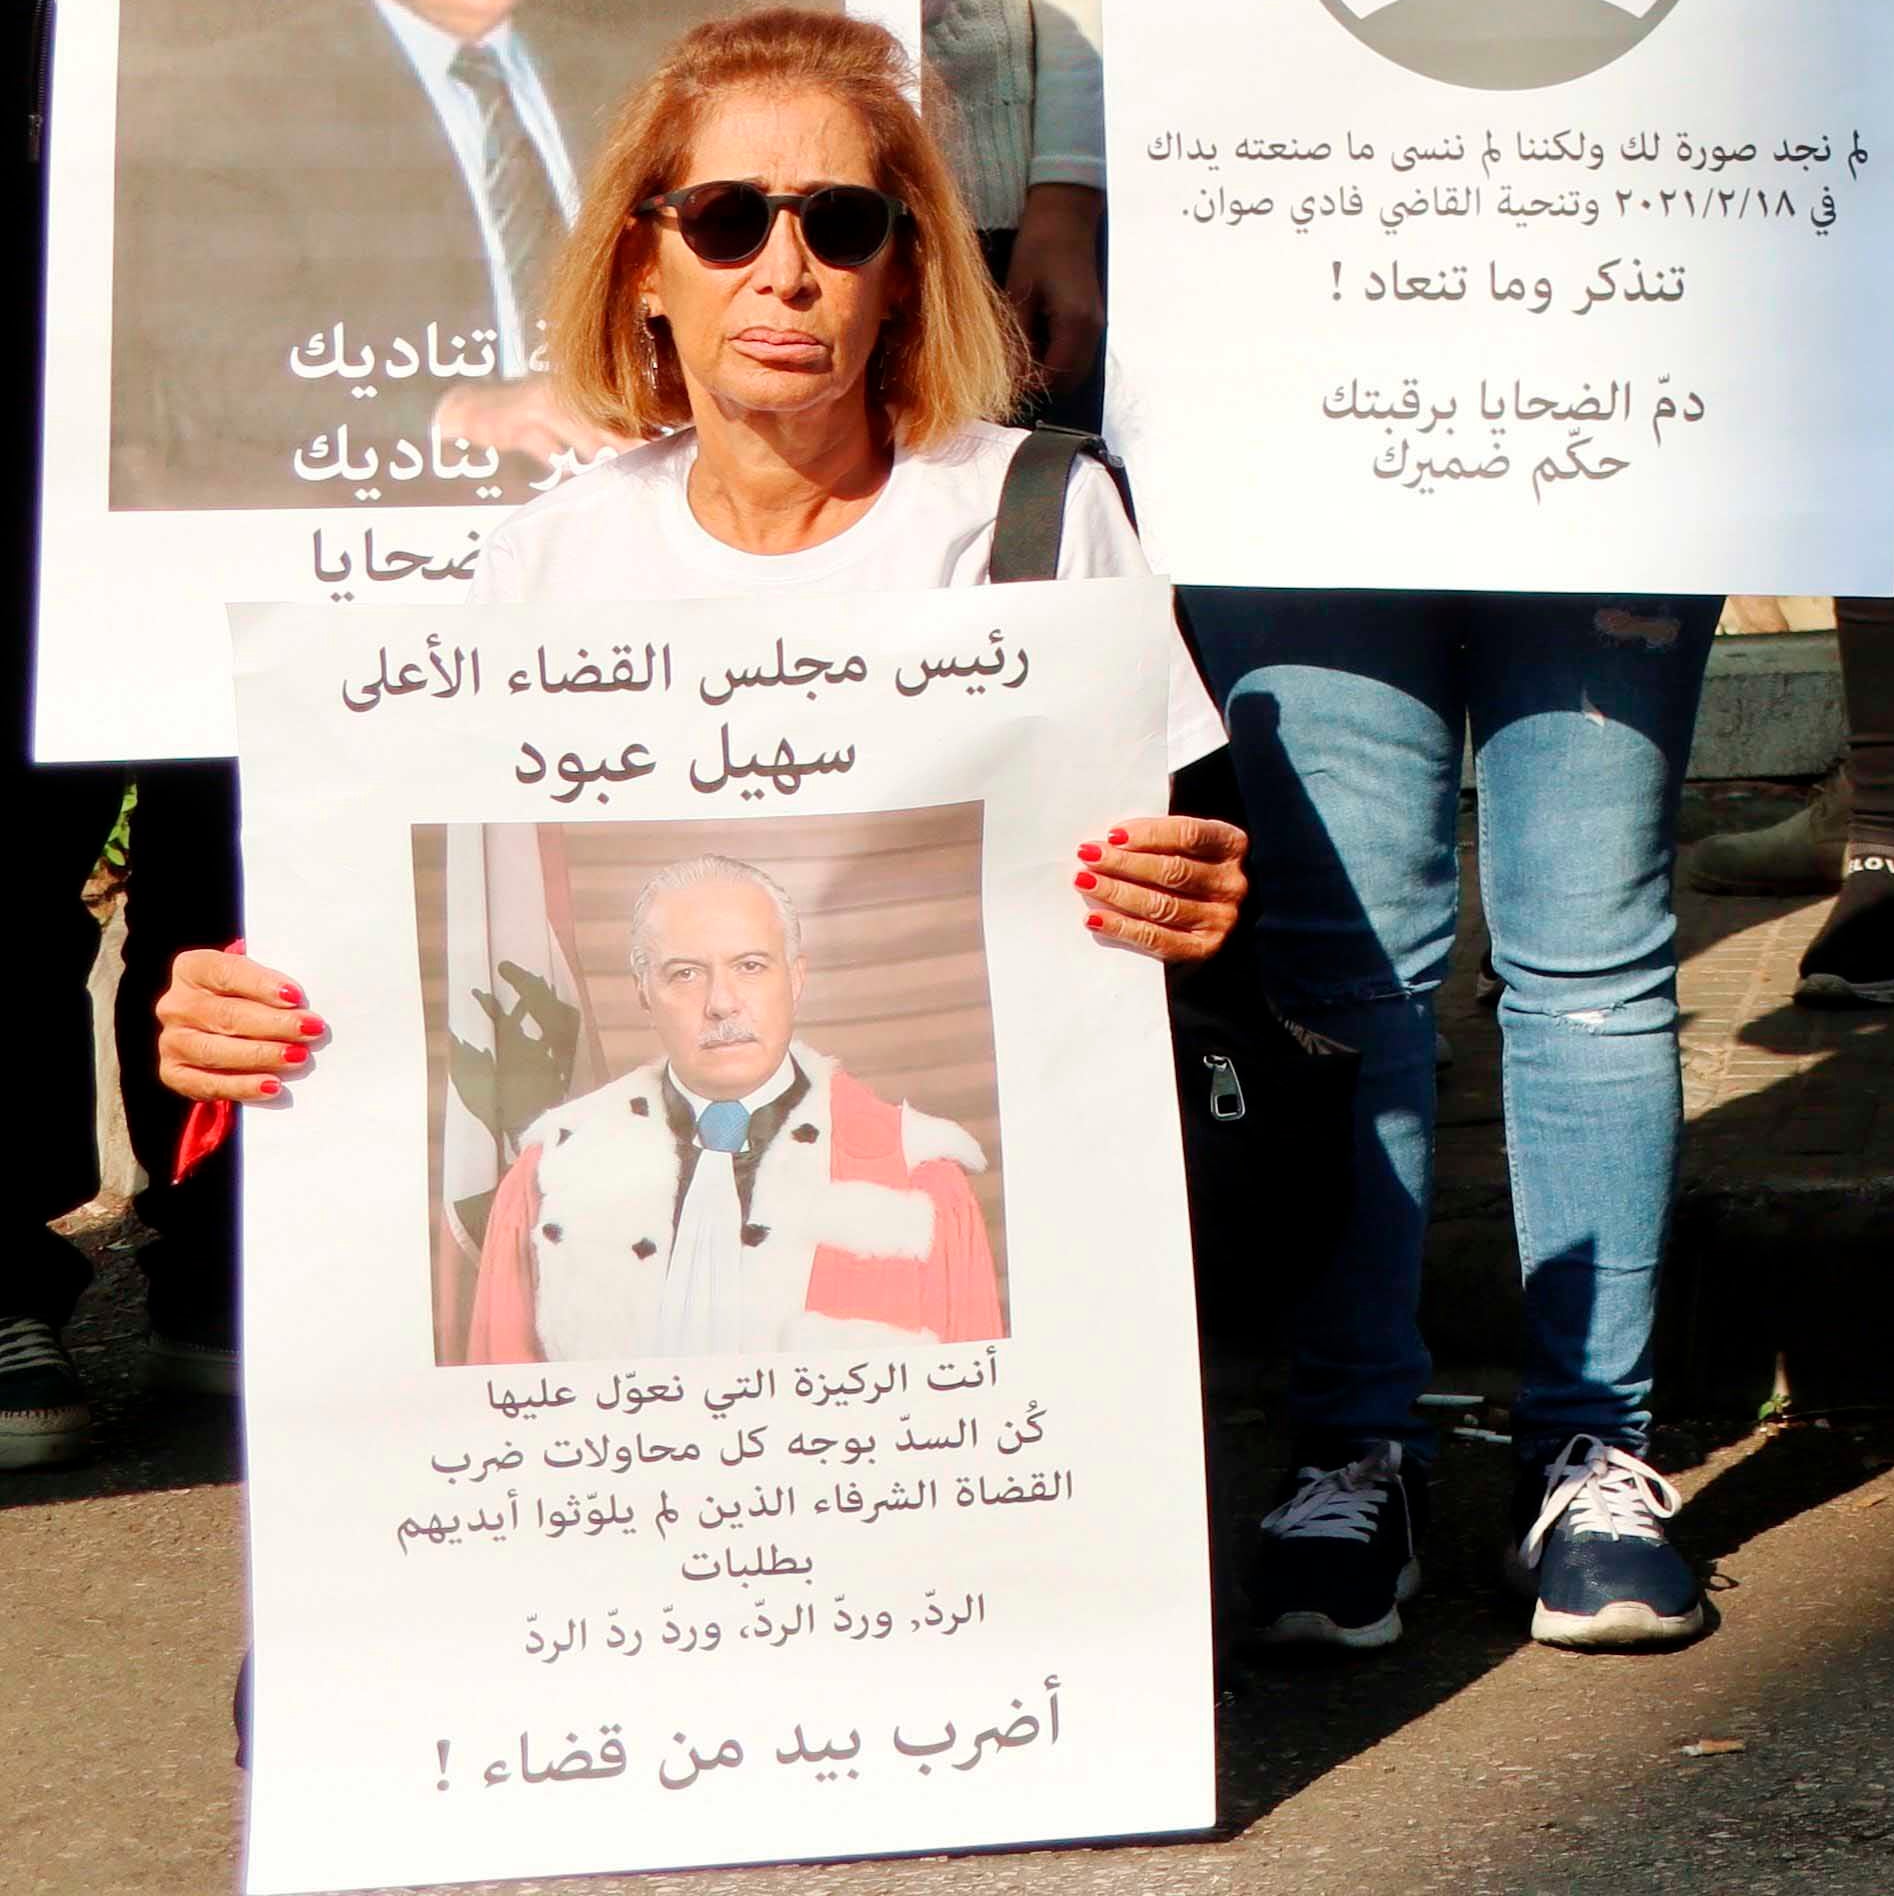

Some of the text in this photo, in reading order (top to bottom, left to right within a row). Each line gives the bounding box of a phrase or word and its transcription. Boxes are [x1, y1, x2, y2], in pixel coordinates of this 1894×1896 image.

[1147, 130, 1868, 180] لم نجد صورة لك ولكننا لم ننسى ما صنعته يداك
[1183, 186, 1836, 236] في ٢٠٢١/٢/١٨ وتنحية القاضي فادي صوان.
[1332, 258, 1685, 315] تنذكر وما تنعاد !
[289, 320, 497, 399] تناديك
[1323, 374, 1704, 445] دمّ الضحايا برقبتك
[292, 424, 503, 501] يناديك
[1373, 427, 1630, 504] حكّم ضميرك
[340, 628, 1030, 715] رئيس مجلس القضاء الأعلى
[515, 723, 855, 804] سهيل عبود
[487, 1345, 996, 1420] أنت الركيزة التي نعوّل عليها
[544, 1433, 700, 1473] محاولات
[720, 1426, 768, 1466] كل
[788, 1433, 875, 1464] بوجه
[896, 1415, 977, 1451] السدّ
[431, 1444, 524, 1485] ضرب
[397, 1470, 1072, 1555] القضاة الشرفاء الذين لم يلوّثوا أيديهم
[682, 1544, 812, 1588] بطلبات
[526, 1614, 586, 1664] الردّ
[607, 1608, 642, 1656] ردّ
[662, 1605, 721, 1652] وردّ
[834, 1594, 892, 1640] وردّ
[437, 1674, 1061, 1791] أضرب بيد من قضاء !
